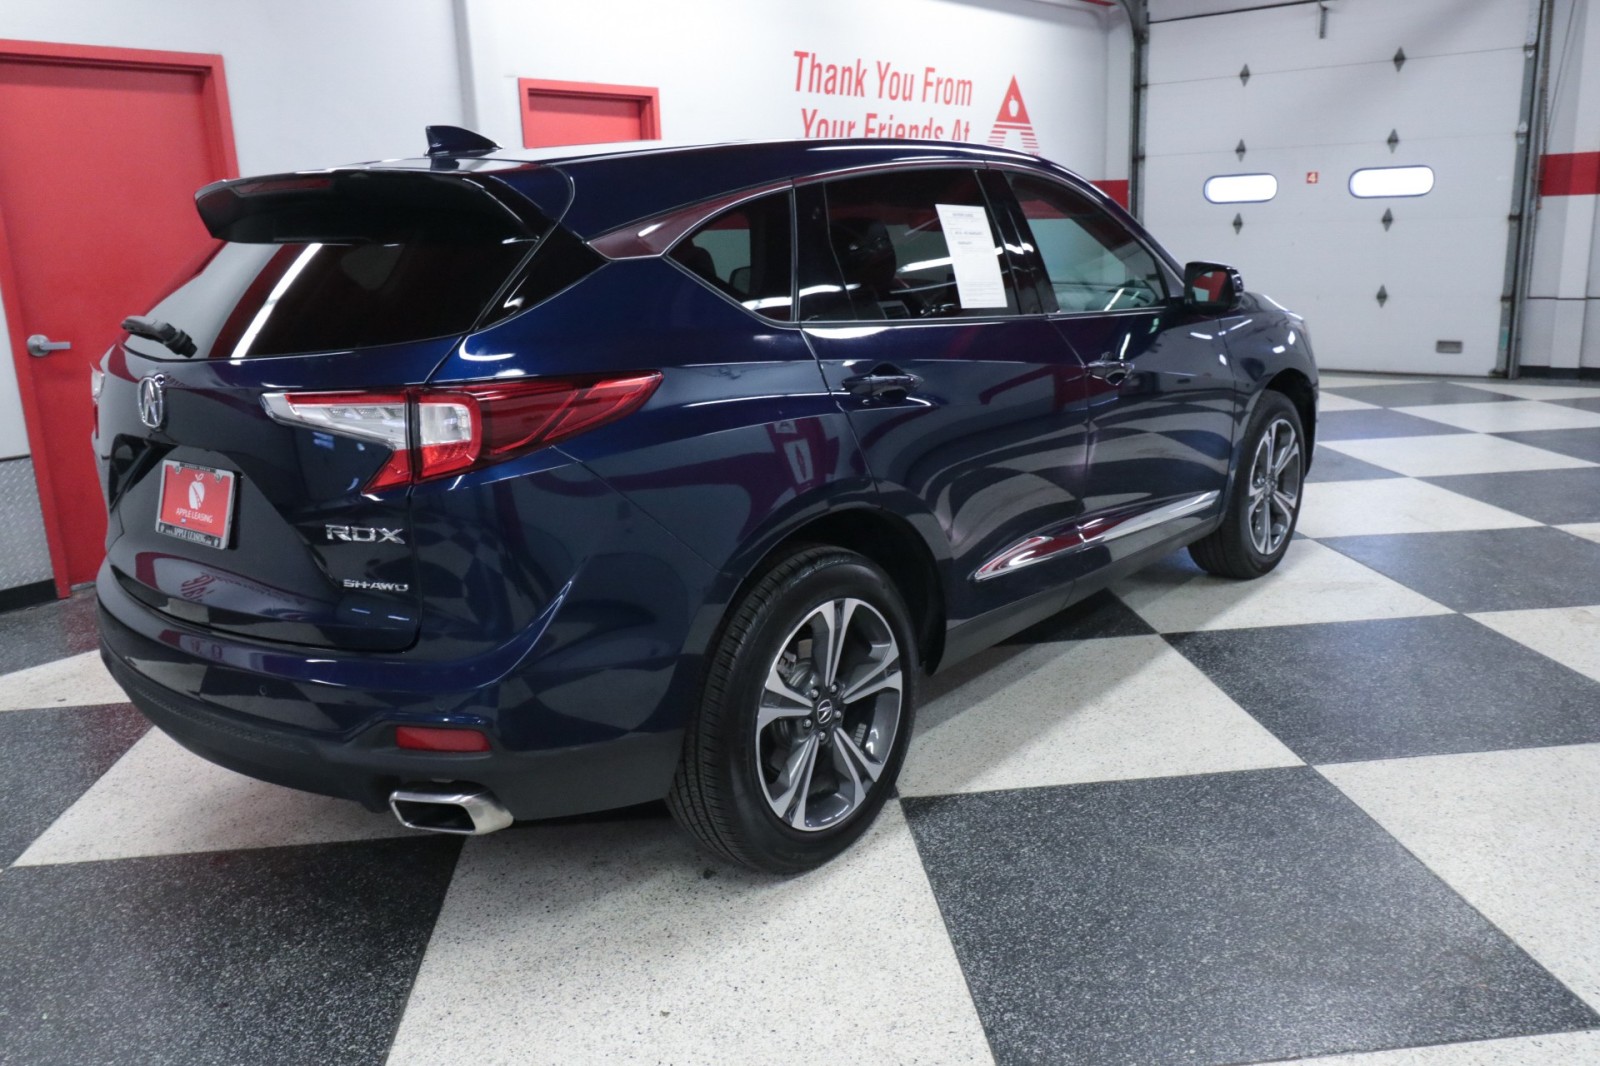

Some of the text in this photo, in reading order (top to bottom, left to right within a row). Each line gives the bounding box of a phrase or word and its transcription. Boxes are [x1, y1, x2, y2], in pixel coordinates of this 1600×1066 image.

[793, 50, 973, 107] Thank You From
[801, 108, 857, 139] Your
[951, 118, 970, 142] At
[1307, 172, 1317, 183] 4
[175, 507, 213, 523] APPLE LEASING
[325, 524, 405, 545] RDX
[343, 579, 408, 591] SH-AWD
